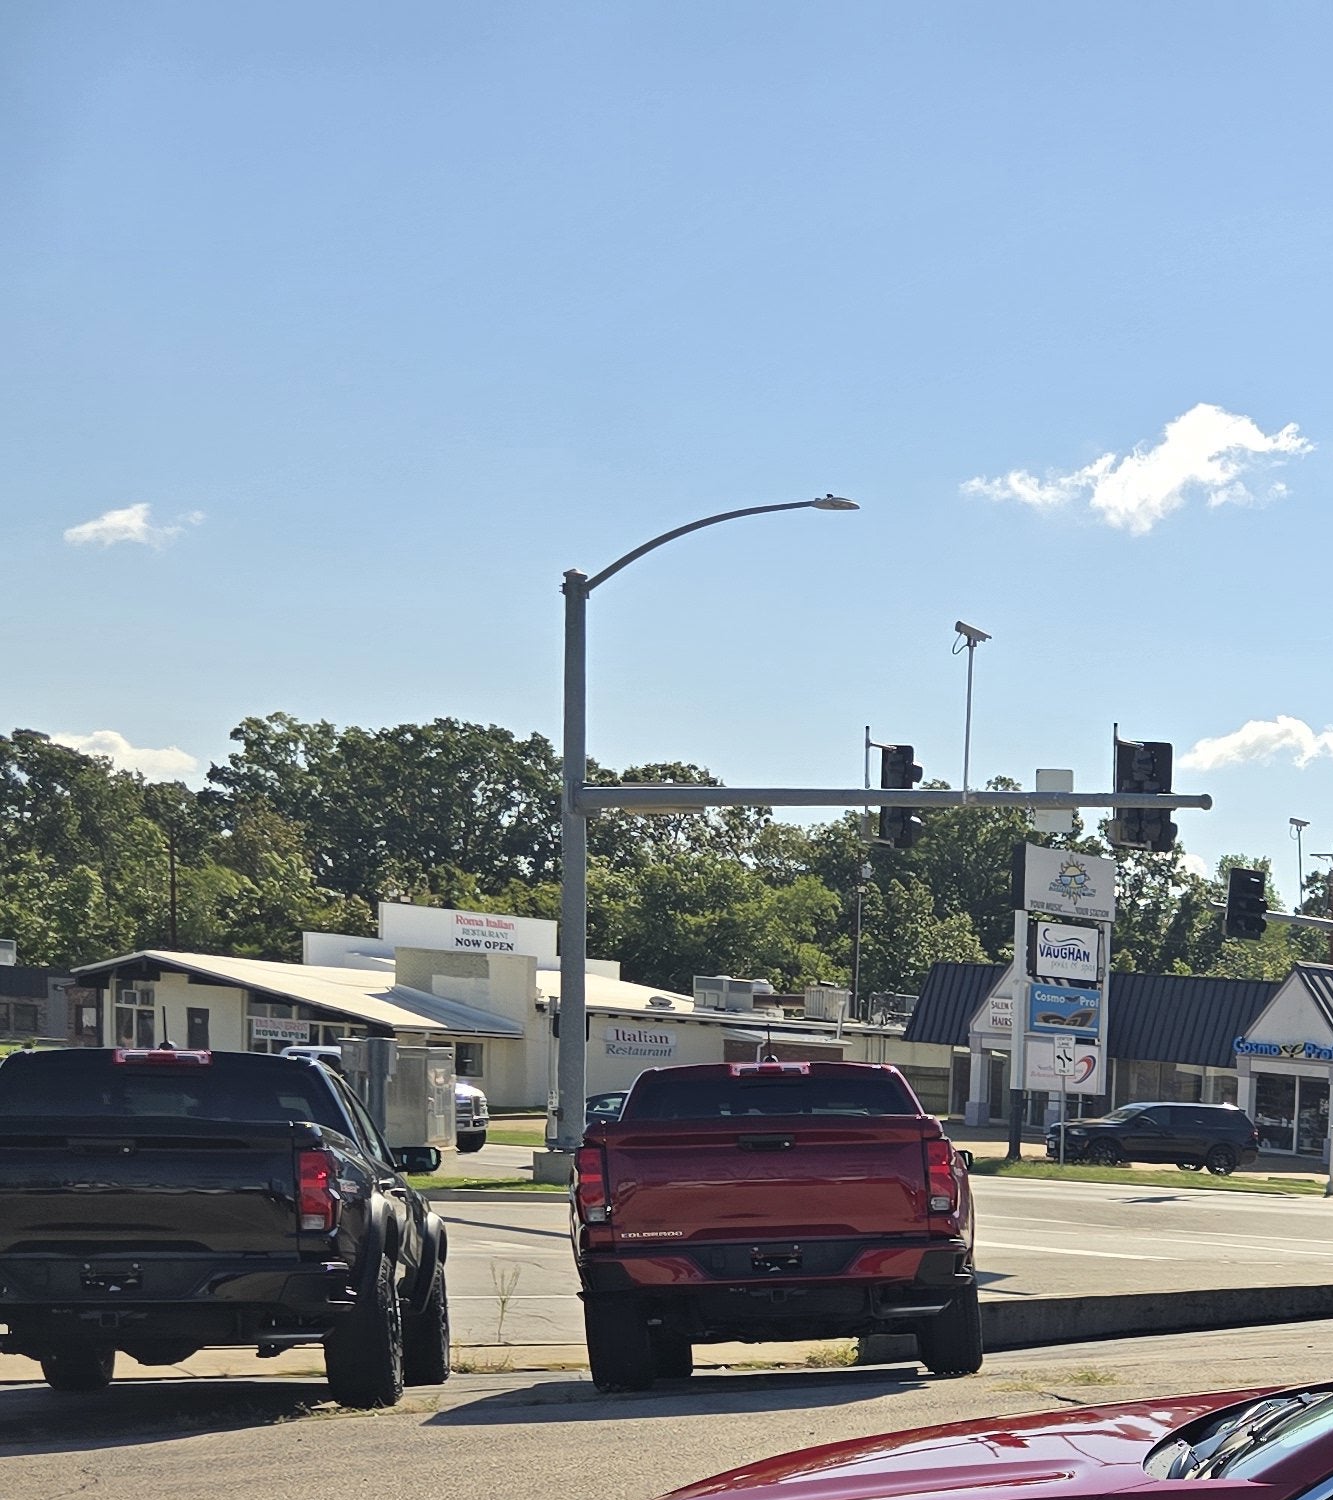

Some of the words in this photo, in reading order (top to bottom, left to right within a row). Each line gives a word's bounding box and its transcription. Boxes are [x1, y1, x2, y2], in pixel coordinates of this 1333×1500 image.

[455, 914, 484, 927] Roma
[486, 918, 515, 930] Italian
[462, 927, 508, 940] RESTAURANT
[455, 937, 482, 948] NOW
[484, 940, 514, 951] OPEN
[1039, 943, 1091, 963] VAUGHAN
[1034, 990, 1066, 1004] Cosmo
[991, 1000, 1009, 1010] SALEM
[281, 1031, 308, 1040] OPEN
[614, 1028, 670, 1045] Italian
[605, 1043, 673, 1057] Restaurant
[1232, 1035, 1282, 1056] Cosmo
[620, 1230, 684, 1239] COLORADO
